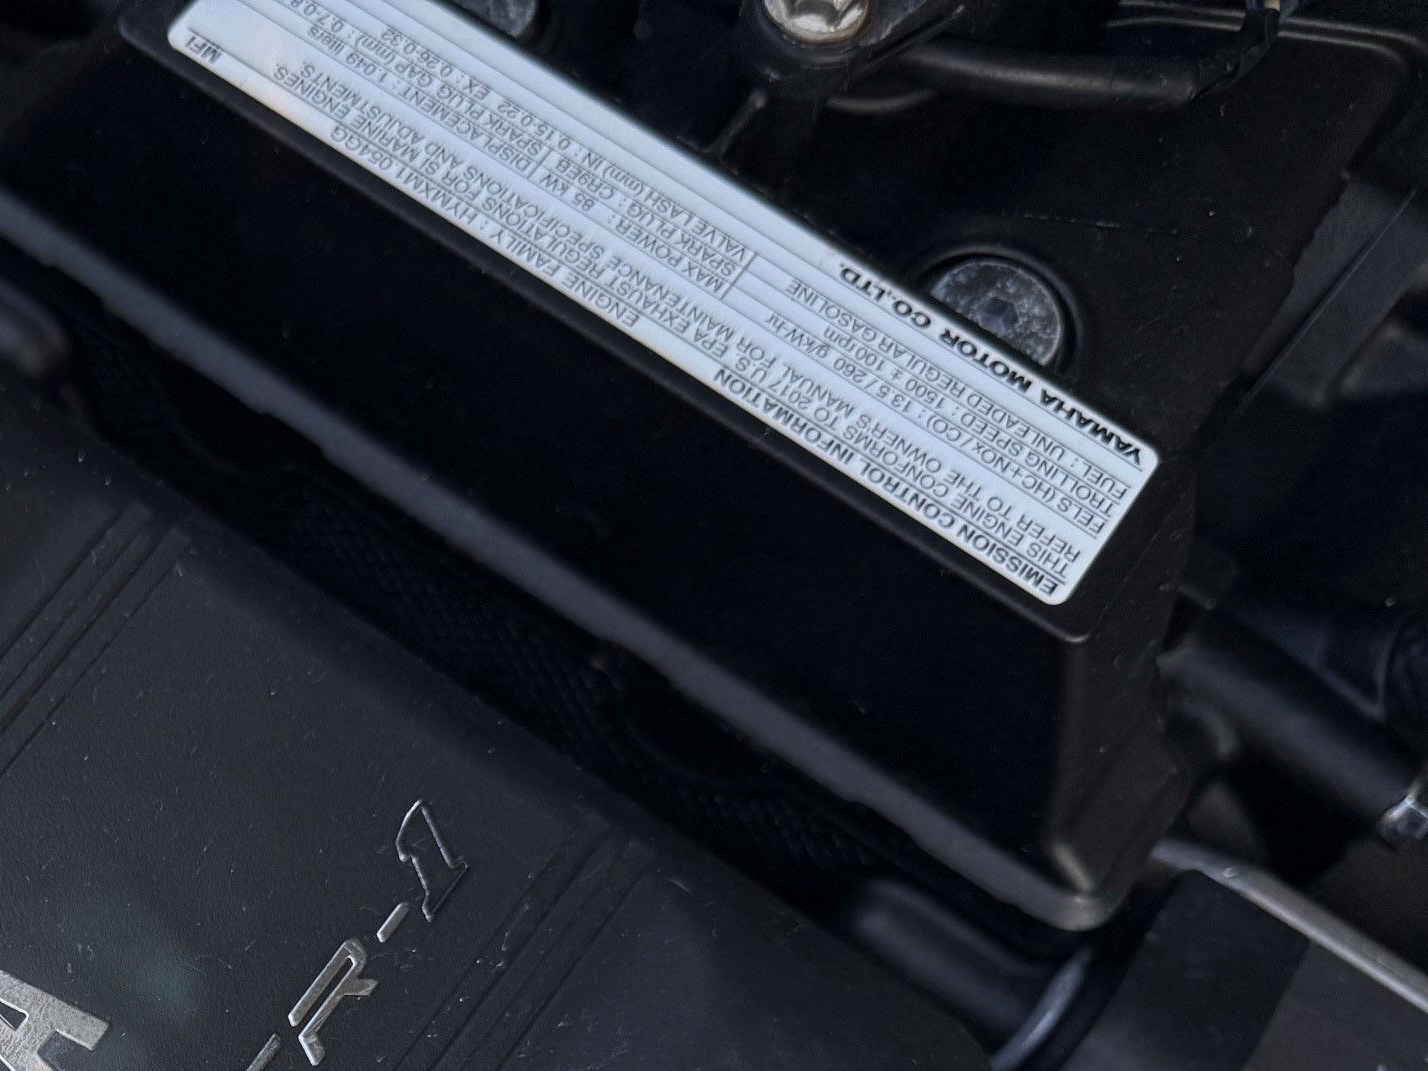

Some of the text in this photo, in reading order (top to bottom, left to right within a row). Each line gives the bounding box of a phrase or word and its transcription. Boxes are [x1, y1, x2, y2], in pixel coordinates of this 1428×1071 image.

[185, 35, 221, 63] MFI
[307, 22, 346, 55] liters
[273, 64, 350, 119] ENGINES.
[394, 57, 434, 87] GAP
[462, 74, 493, 100] EX
[436, 83, 485, 120] PLUG
[497, 95, 574, 150] 0.15-0.22
[350, 115, 420, 162] MARINE
[398, 85, 531, 171] DISPLACEMENT
[482, 113, 541, 158] SPARK
[580, 148, 605, 170] IN
[440, 170, 481, 201] FOR
[538, 172, 569, 196] kW
[626, 202, 677, 239] PLUG
[643, 188, 694, 226] LASH
[482, 196, 604, 279] REGULATIONS
[488, 228, 561, 277] FAMILY
[615, 218, 683, 267] POWER
[674, 233, 735, 276] SPARK
[691, 220, 745, 262] VALVE
[681, 260, 724, 293] MAX
[300, 61, 1080, 562] REFER TO THE OWNER'S MANUAL FOR MAINTENANCE SPECIFICATIONS AND ADJUSTMENTS.
[561, 272, 639, 327] ENGINE
[604, 275, 691, 334] EXHAUST
[785, 277, 877, 342] GASOLINE
[693, 327, 729, 358] EPA
[939, 329, 1032, 392] MOTOR
[735, 353, 768, 384] U.S.
[878, 335, 966, 398] REGULAR
[767, 378, 812, 410] 2017
[904, 375, 945, 408] 1500
[813, 406, 838, 431] TO
[960, 412, 1023, 456] SPEED
[966, 393, 1065, 460] UNLEADED
[1040, 389, 1140, 464] YAMAHA
[713, 369, 1058, 594] EMISSION CONTROL INFORMATION
[843, 425, 949, 497] CONFORMS
[1083, 462, 1127, 500] FUEL
[1024, 451, 1113, 517] TROLLING
[951, 494, 1024, 546] ENGINE
[1057, 496, 1105, 534] FELS
[1026, 542, 1068, 578] THIS
